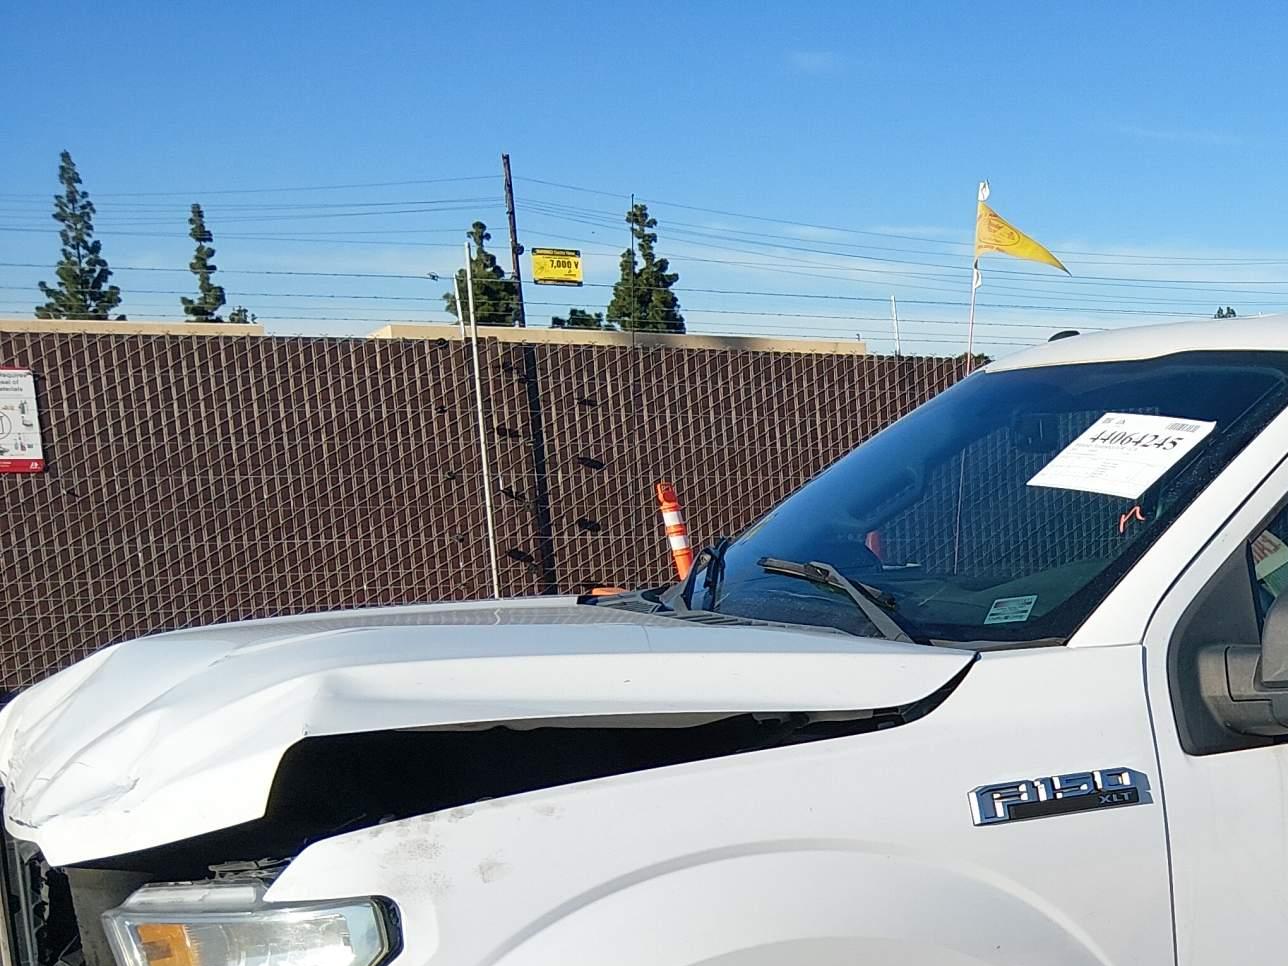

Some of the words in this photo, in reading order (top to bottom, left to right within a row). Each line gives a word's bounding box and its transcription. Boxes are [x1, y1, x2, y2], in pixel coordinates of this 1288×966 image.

[550, 260, 572, 269] 7,000
[1089, 430, 1185, 450] 44064245
[1099, 791, 1132, 805] XLT
